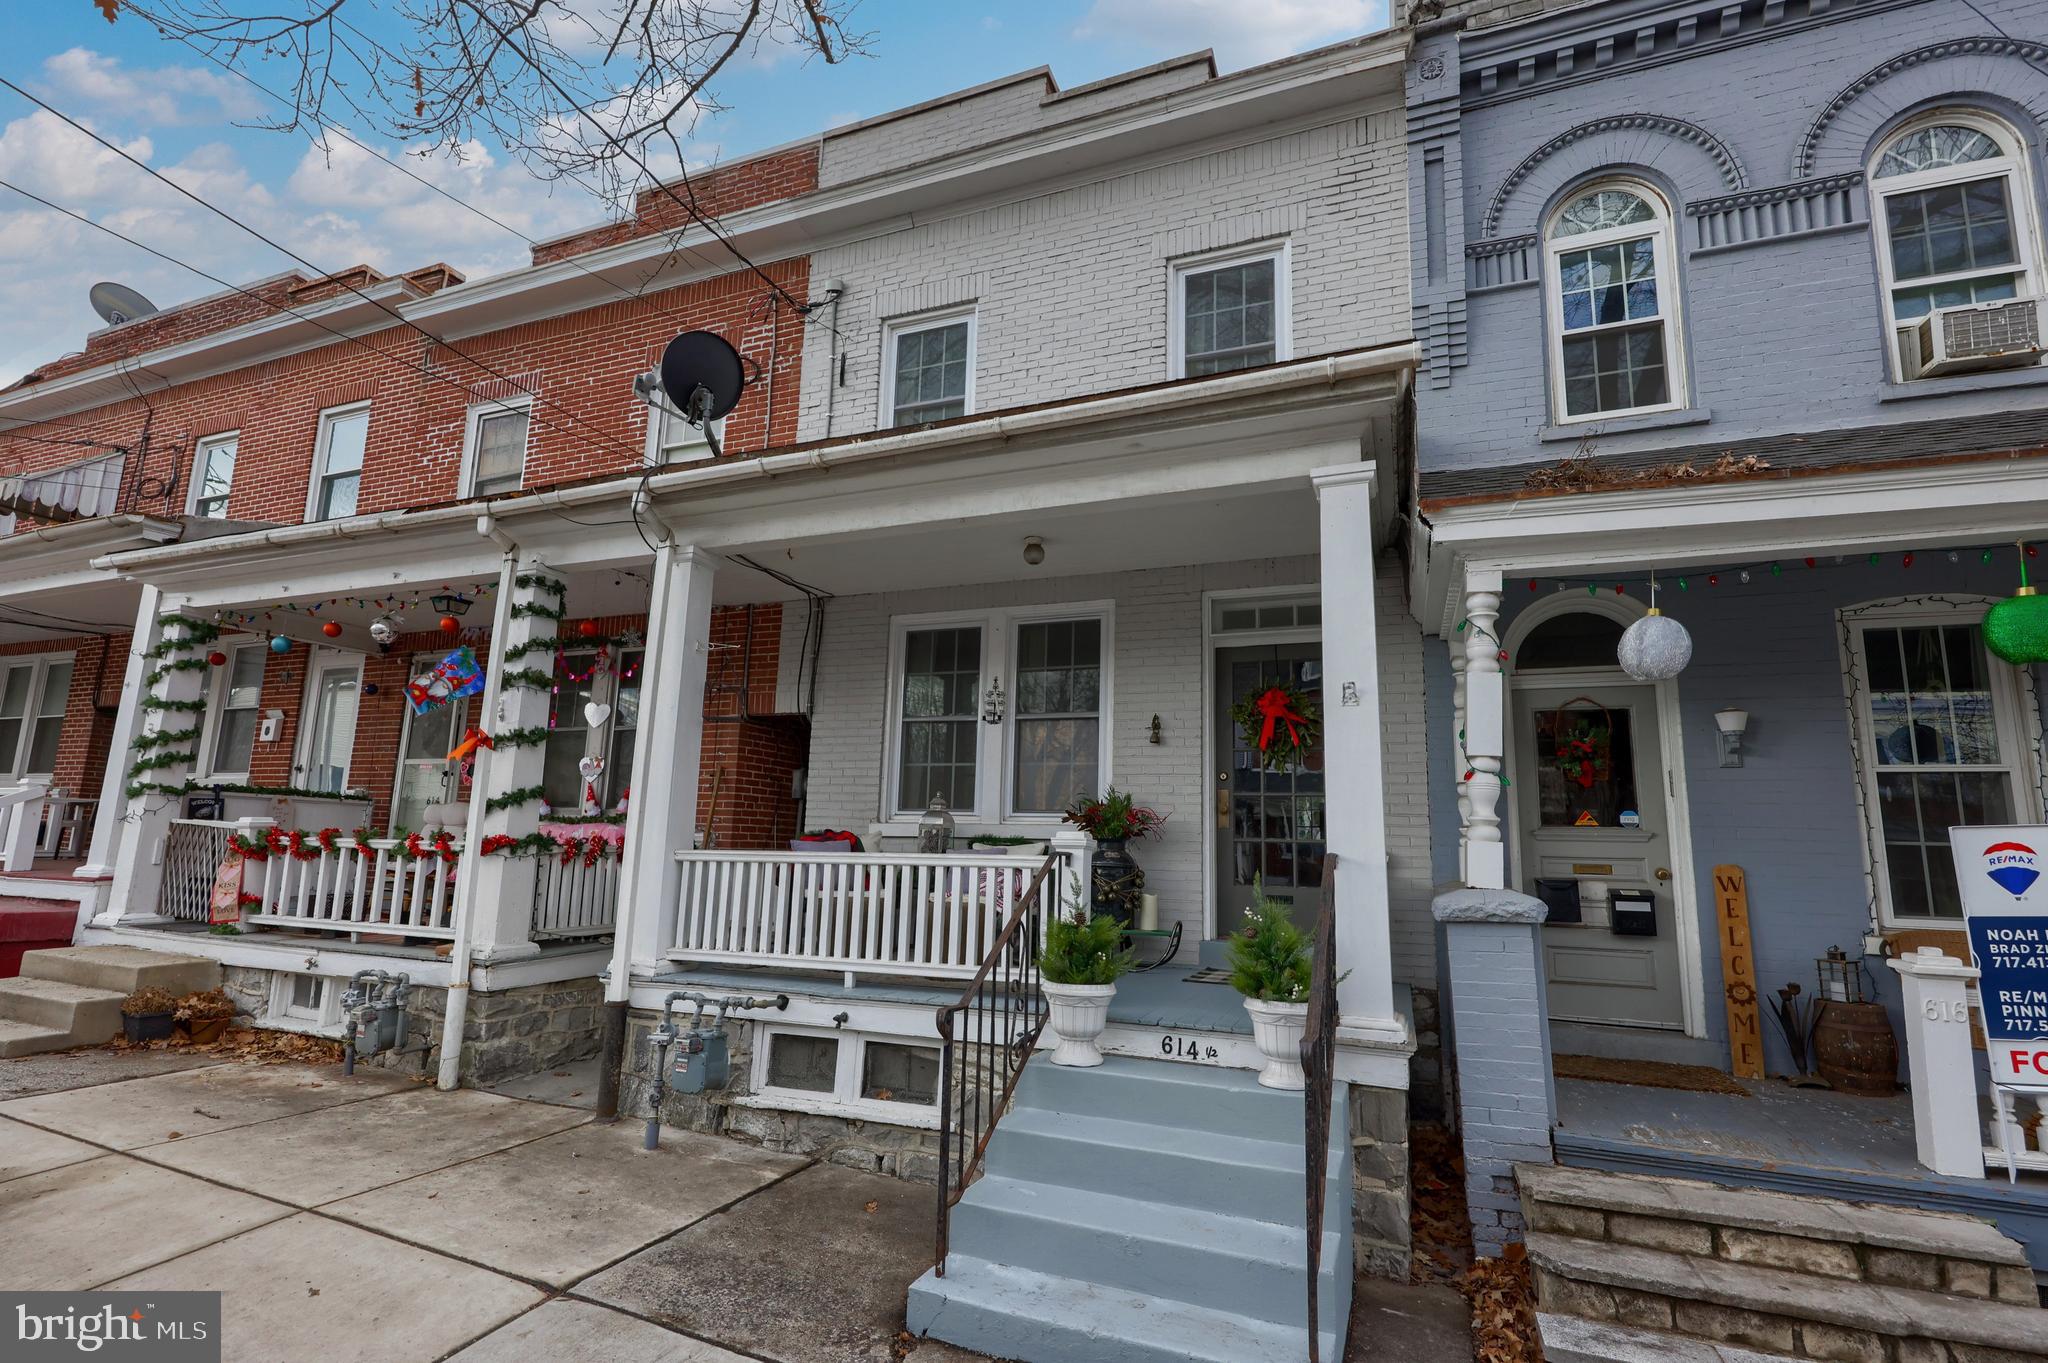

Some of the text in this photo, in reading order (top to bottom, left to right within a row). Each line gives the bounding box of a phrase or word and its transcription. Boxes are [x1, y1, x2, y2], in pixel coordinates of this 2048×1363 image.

[1988, 855, 2034, 866] RE/MAX
[218, 881, 237, 889] KISS
[1986, 929, 2039, 941] NOAH
[1989, 944, 2031, 954] BRAD
[1924, 1000, 1968, 1024] 616
[1161, 1035, 1199, 1060] 614
